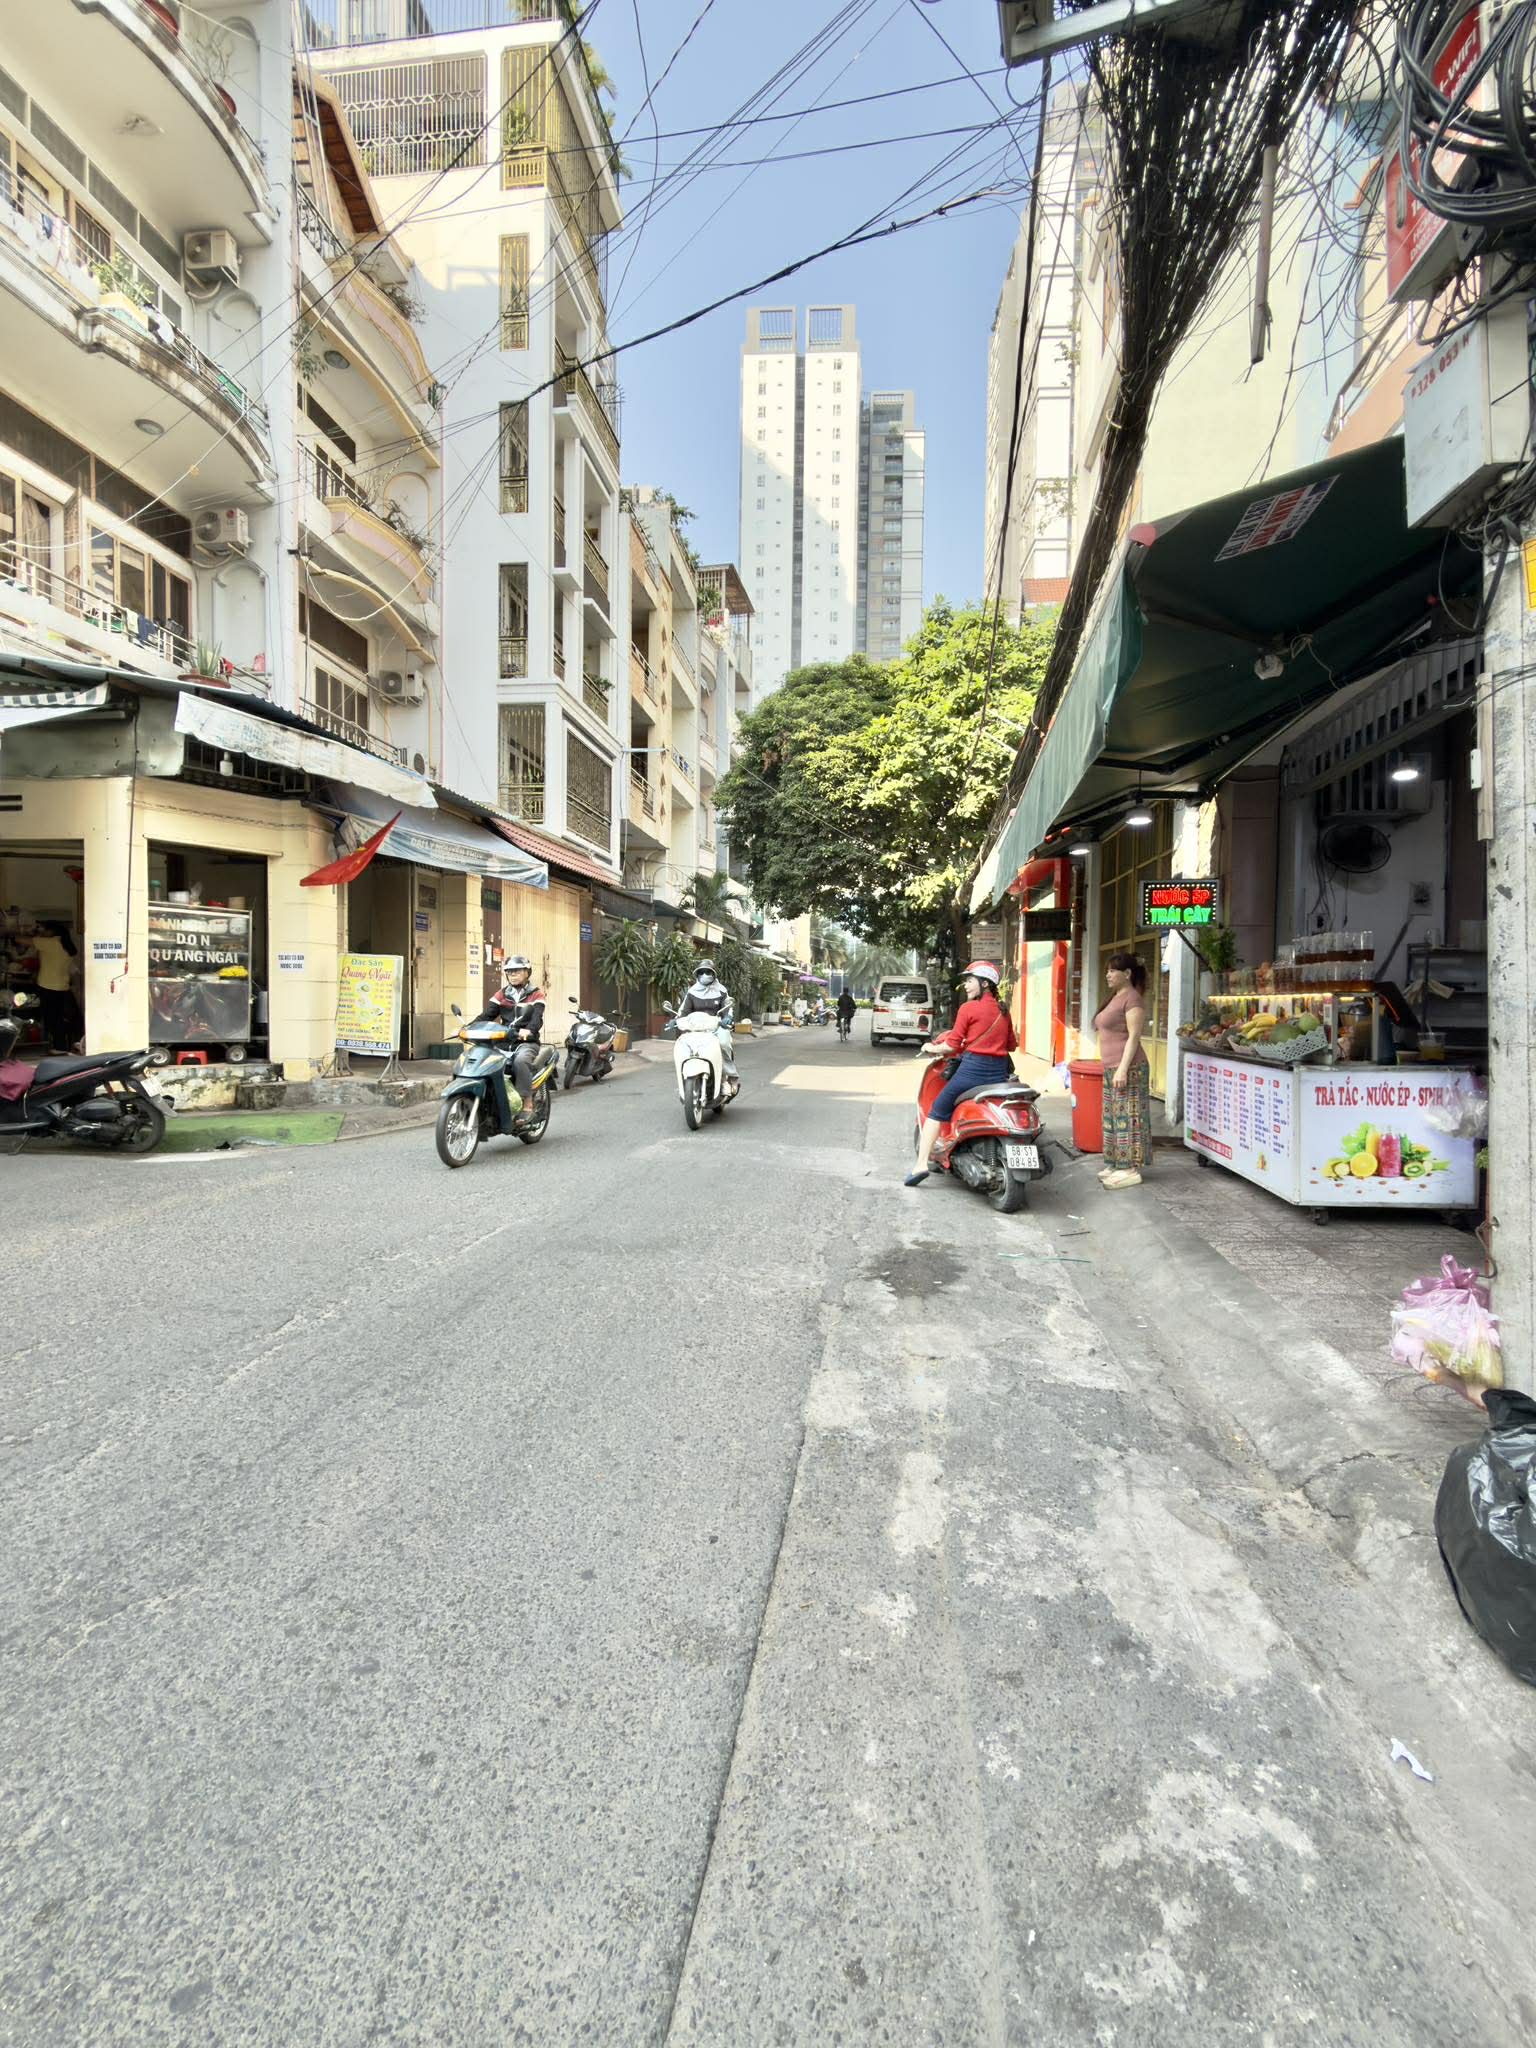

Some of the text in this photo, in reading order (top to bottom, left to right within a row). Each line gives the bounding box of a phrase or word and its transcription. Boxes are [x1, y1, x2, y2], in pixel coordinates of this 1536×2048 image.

[1152, 885, 1211, 905] NƯỚC ÉP
[1149, 904, 1212, 922] TRÁI CÂY
[150, 948, 239, 964] QUANG NGAI
[1315, 1081, 1336, 1107] TRÀ
[1338, 1076, 1358, 1106] TẮC
[1366, 1081, 1395, 1107] NƯỚC
[1398, 1081, 1411, 1107] ÉP
